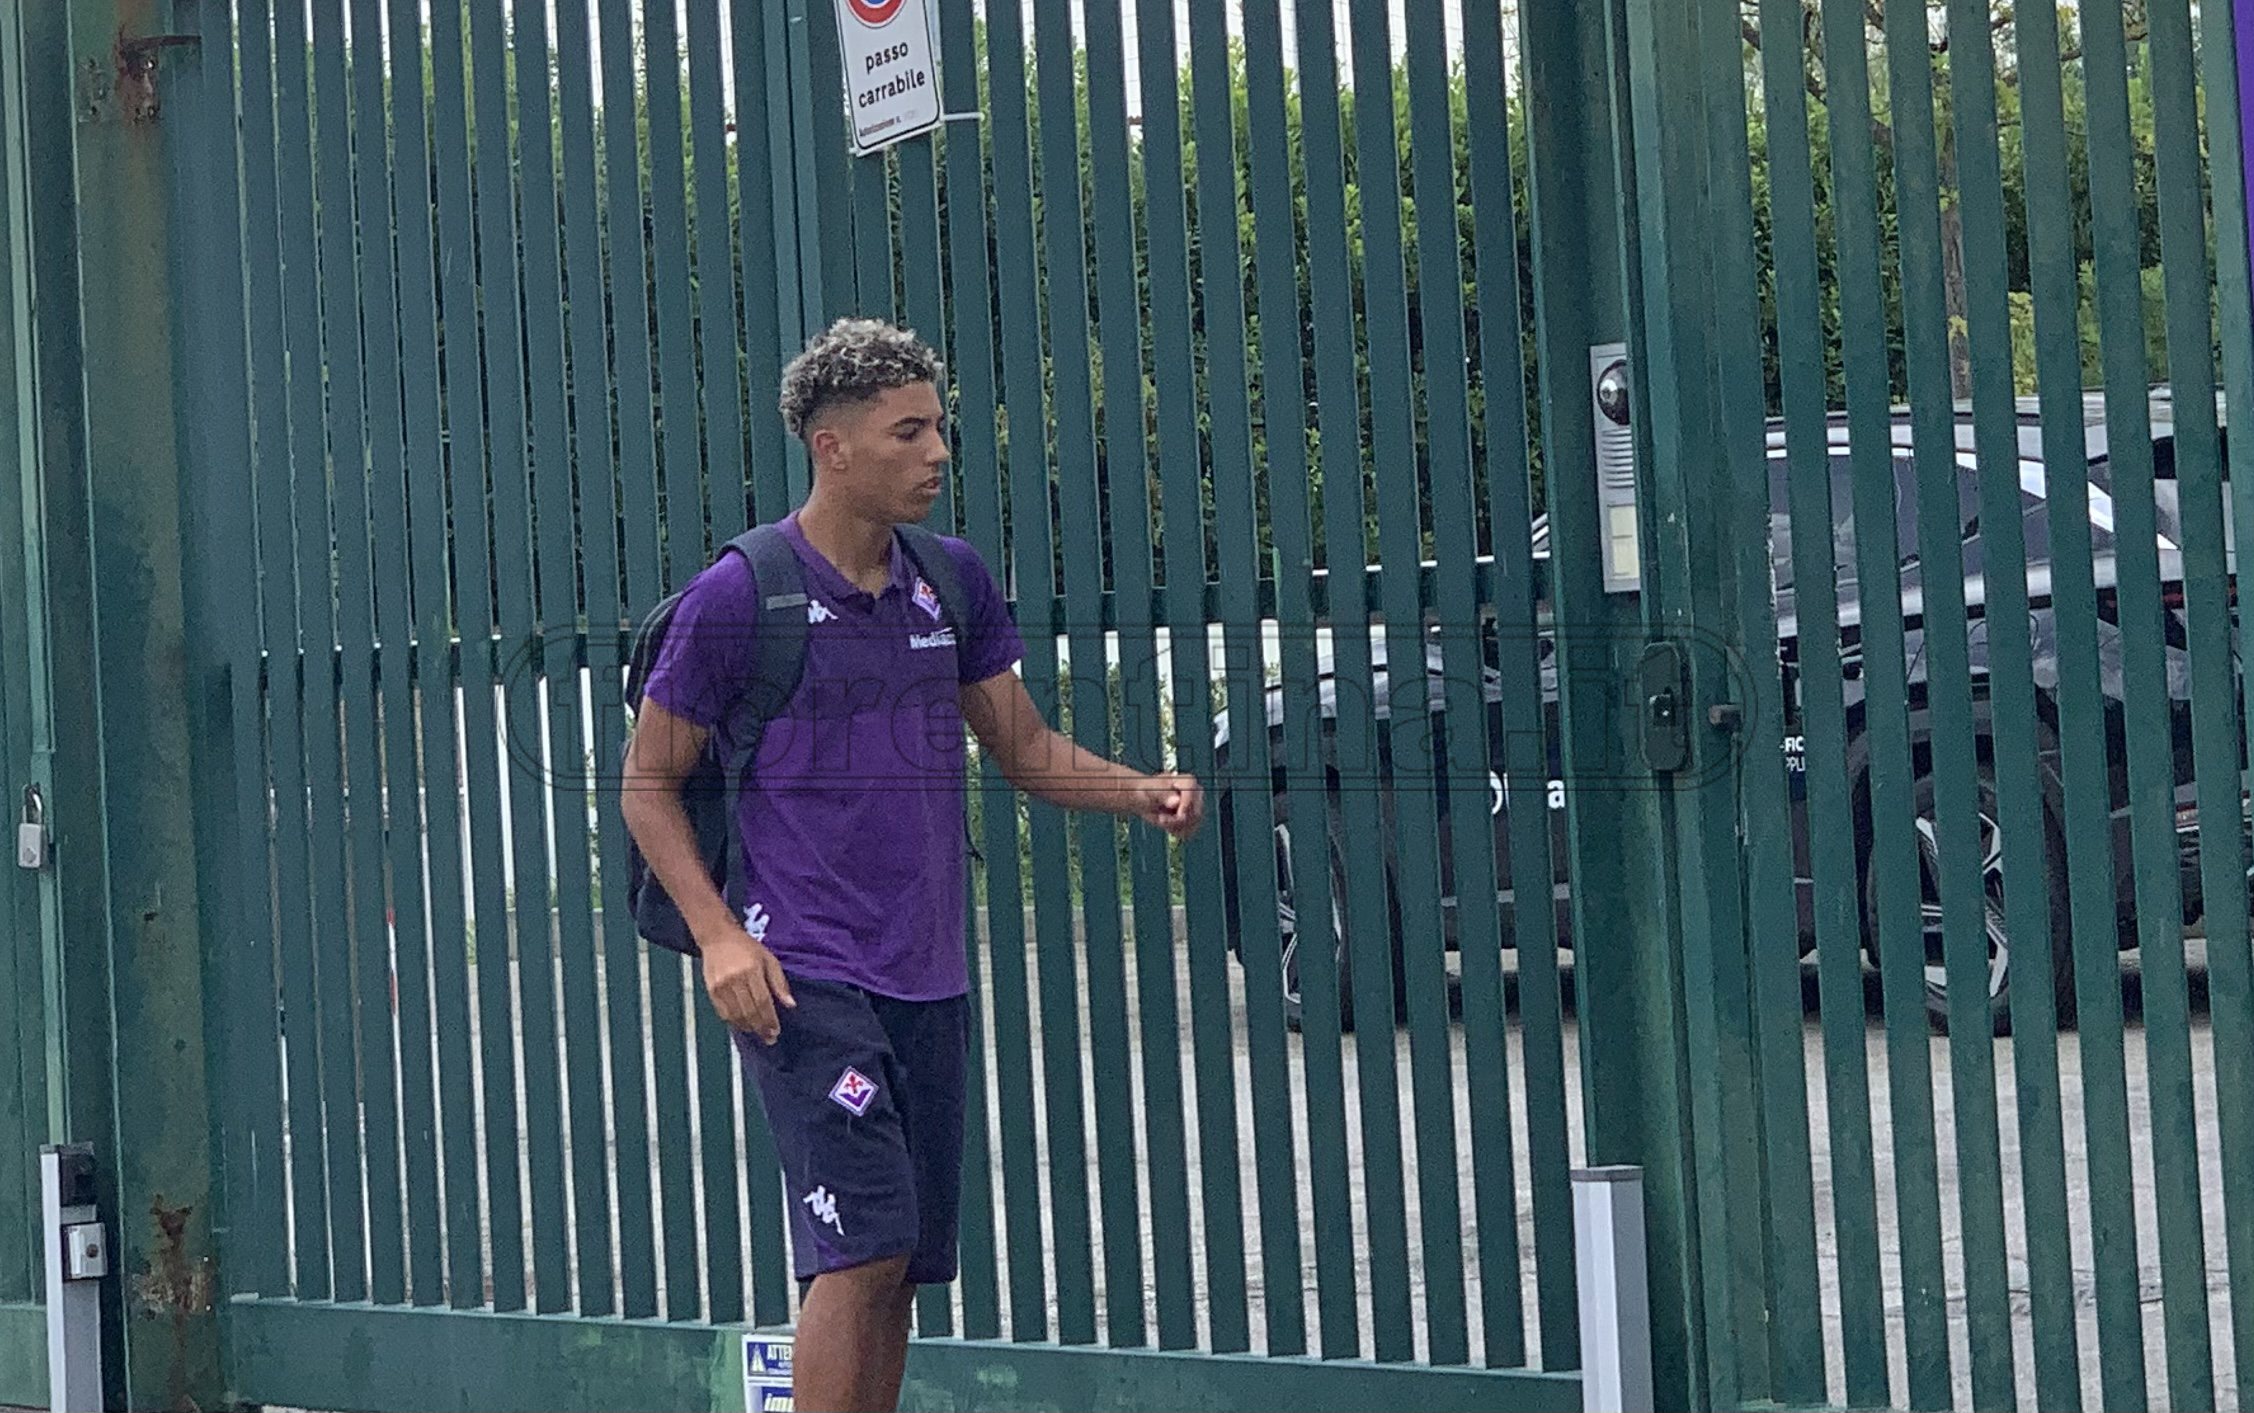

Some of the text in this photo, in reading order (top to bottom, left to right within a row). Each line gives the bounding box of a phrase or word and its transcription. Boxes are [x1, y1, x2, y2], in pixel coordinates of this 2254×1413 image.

[865, 42, 909, 74] passo
[858, 69, 926, 108] carrabile
[1780, 736, 1805, 752] FIC
